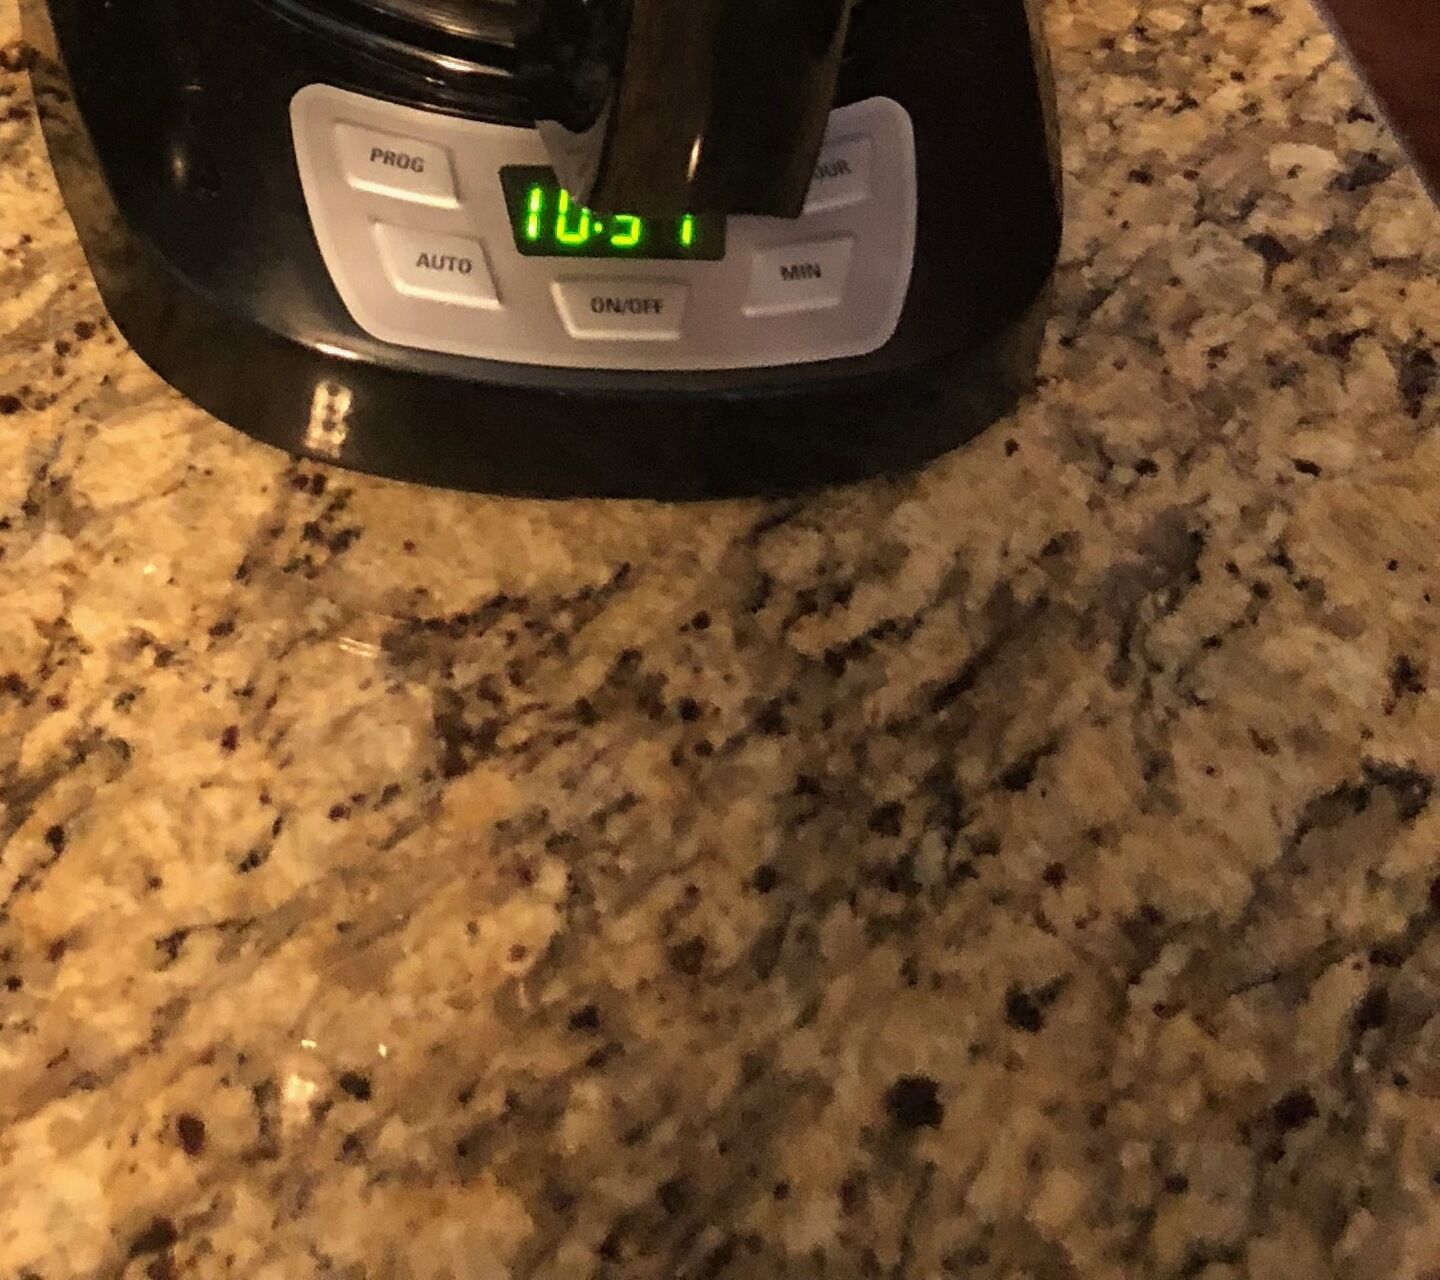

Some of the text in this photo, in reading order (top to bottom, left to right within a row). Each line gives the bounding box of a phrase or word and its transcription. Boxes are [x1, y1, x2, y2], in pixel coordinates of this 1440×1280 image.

[369, 146, 425, 174] PROG
[814, 159, 852, 180] OUR
[415, 251, 473, 275] AUTO
[779, 261, 822, 281] MIN
[589, 295, 663, 316] ON/OFF
